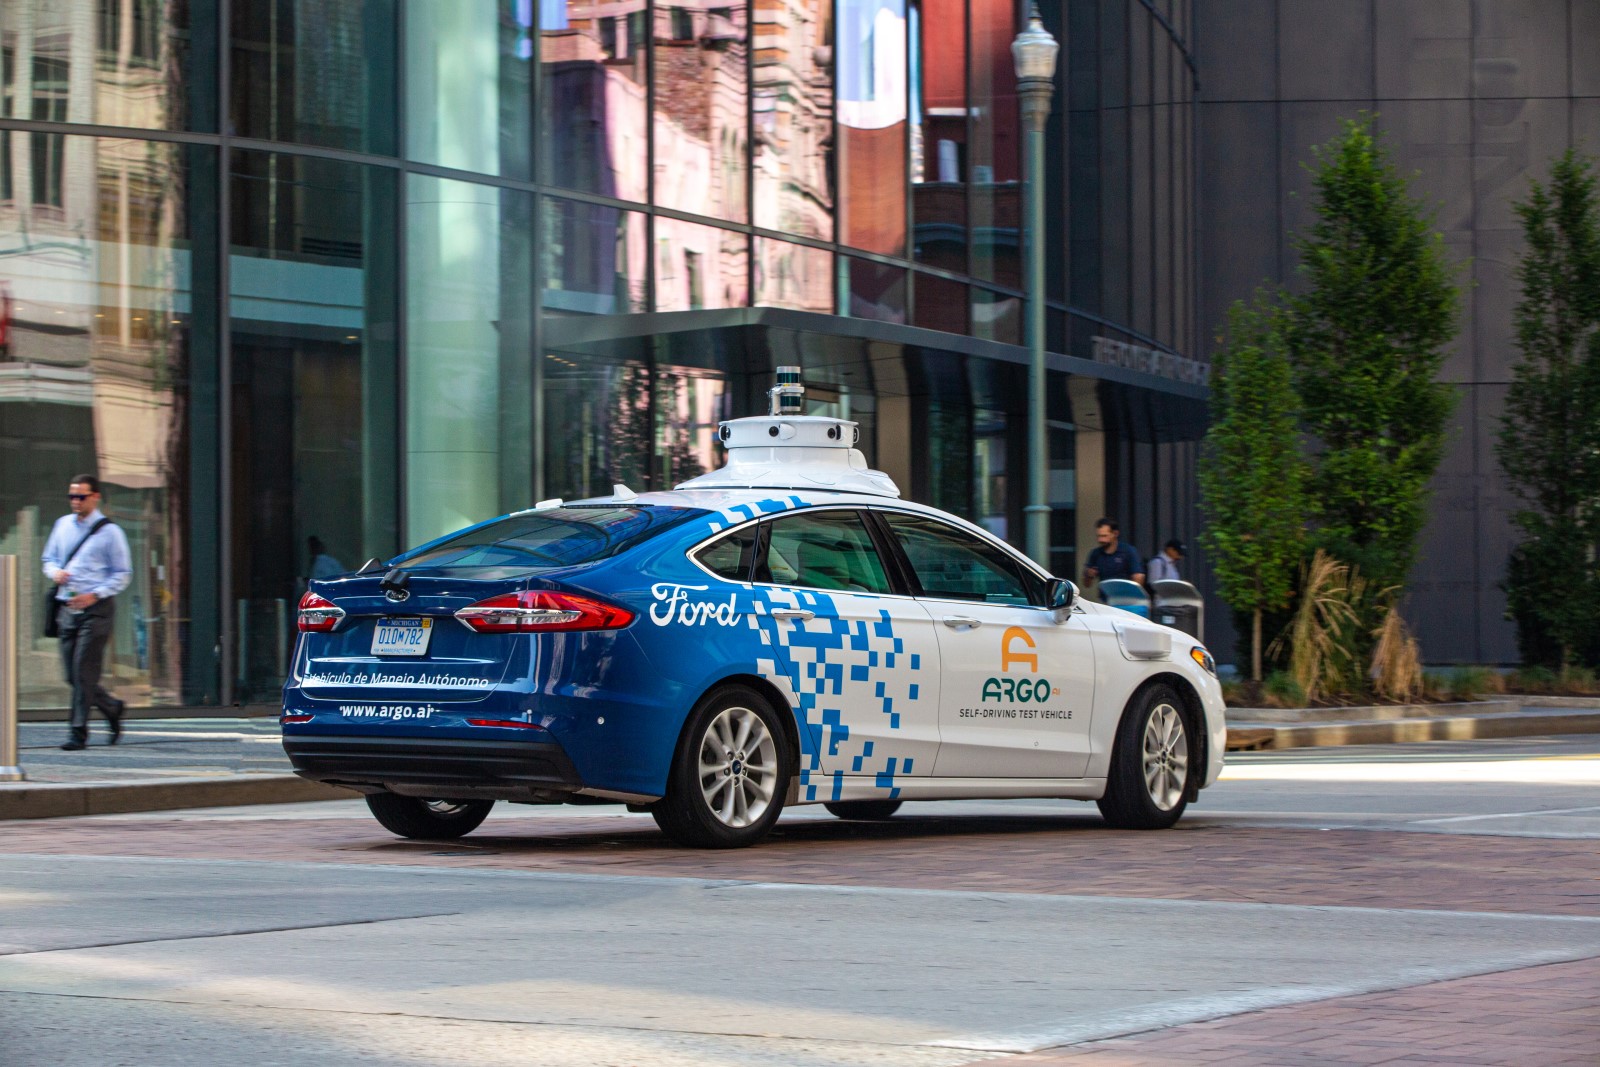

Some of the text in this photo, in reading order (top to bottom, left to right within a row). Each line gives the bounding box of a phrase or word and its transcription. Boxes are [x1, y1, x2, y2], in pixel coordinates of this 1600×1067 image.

[649, 582, 742, 627] Ford
[353, 671, 368, 684] de
[417, 673, 489, 688] Autónomo
[981, 677, 1052, 703] ARGO
[341, 703, 432, 721] www.argo.ai
[959, 708, 1073, 720] SELF-DRIVING TEST VEHICLE
